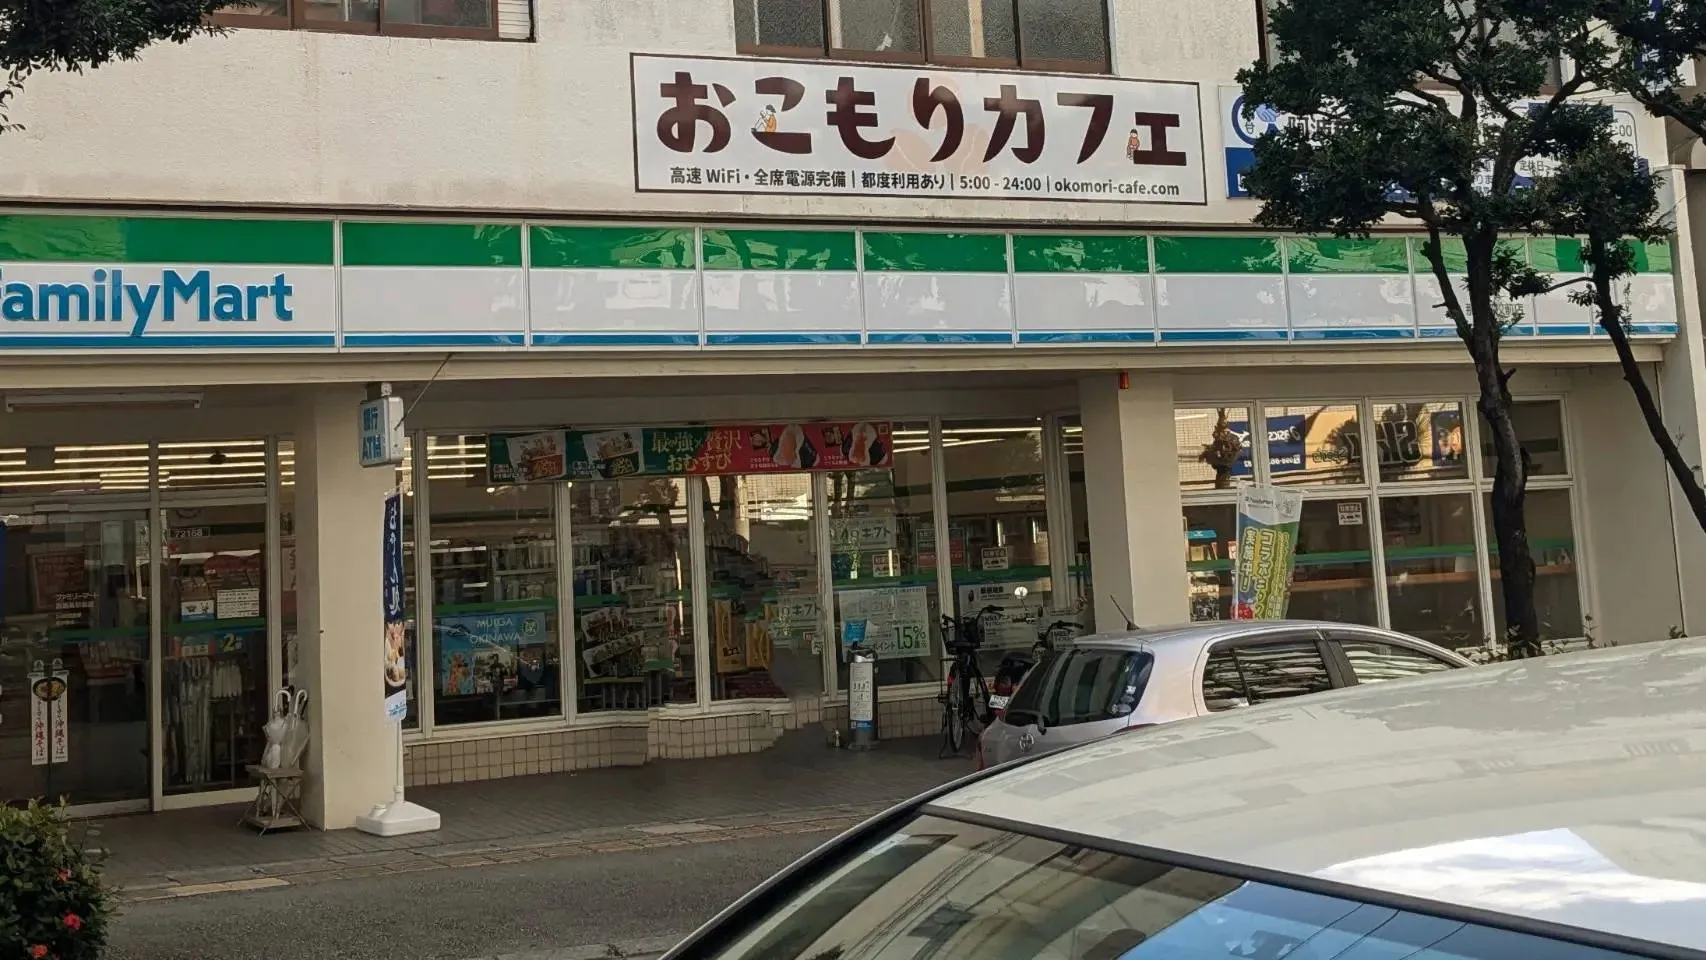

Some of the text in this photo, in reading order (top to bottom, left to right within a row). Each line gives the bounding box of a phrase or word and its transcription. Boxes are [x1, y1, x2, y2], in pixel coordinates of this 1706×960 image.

[656, 71, 1187, 166] おこもりカフェ
[670, 167, 702, 184] 高速
[861, 171, 946, 190] 都度利用あり
[959, 175, 991, 190] 5:00
[1002, 176, 1042, 191] 24:00
[1054, 176, 1181, 196] okomori-cafe.com
[0, 268, 294, 337] amilyMart
[667, 452, 732, 472] おむすび
